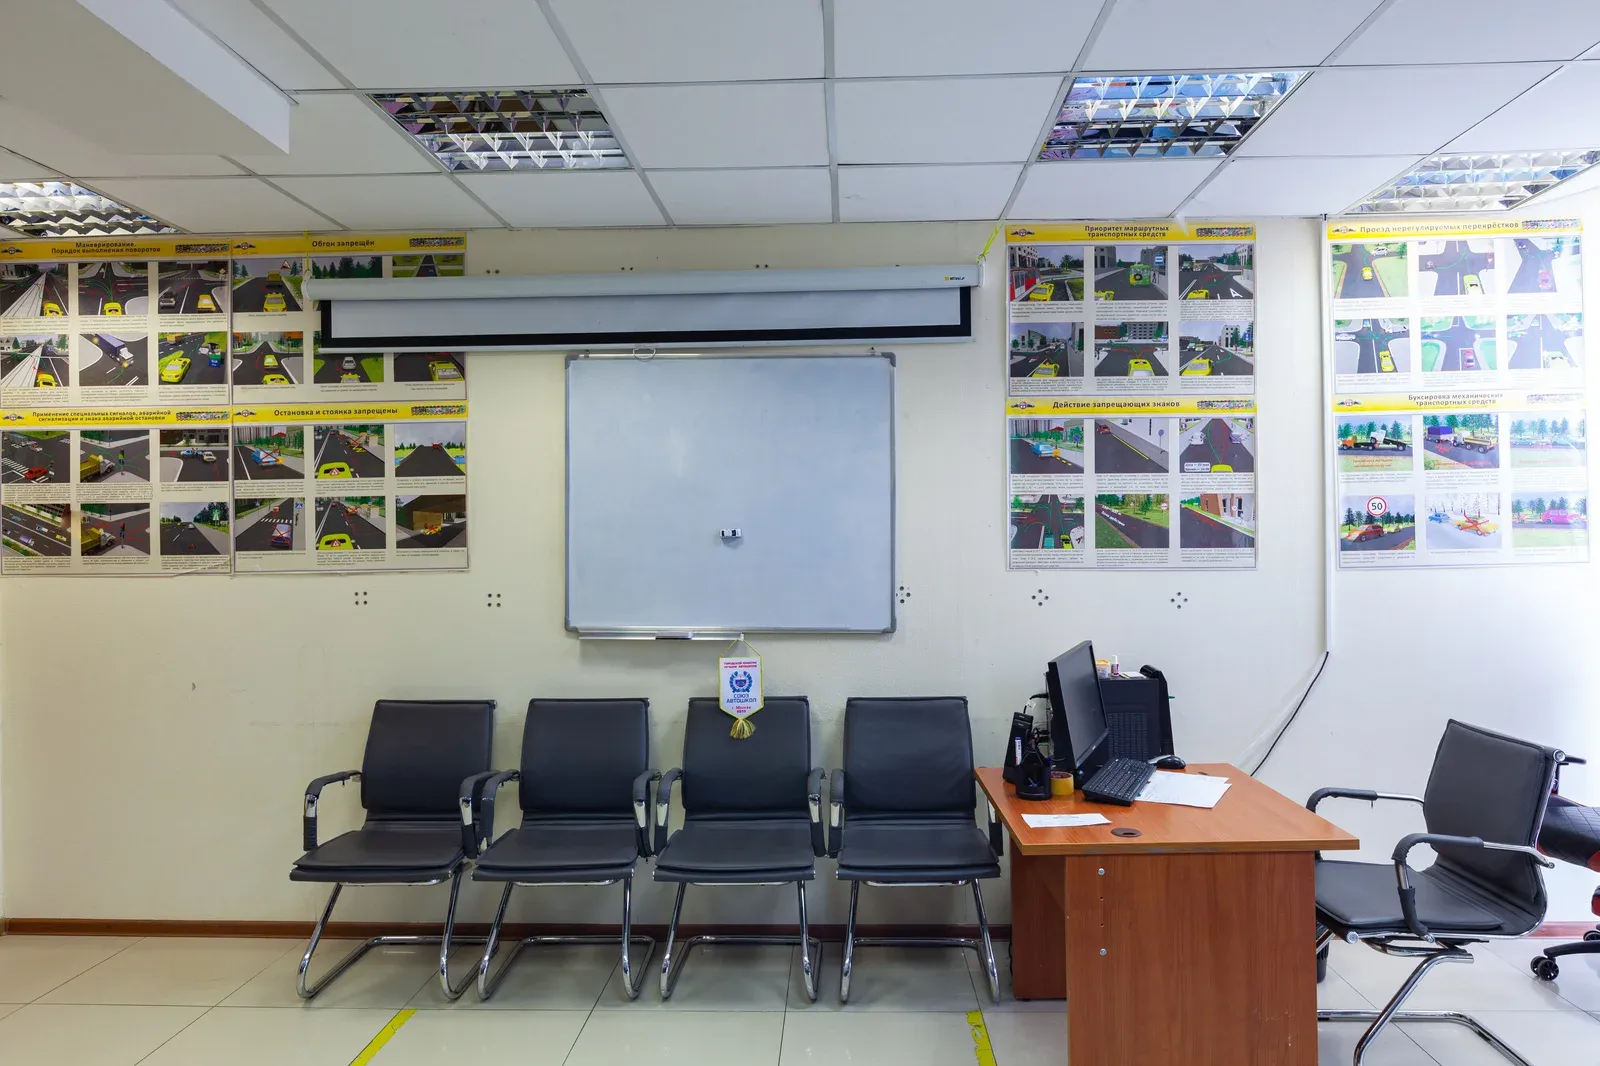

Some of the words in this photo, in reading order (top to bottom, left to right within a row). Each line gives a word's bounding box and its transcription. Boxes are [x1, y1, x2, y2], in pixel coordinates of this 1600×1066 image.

[1085, 225, 1122, 233] Приоритет
[1124, 225, 1169, 233] маршрутных
[1360, 225, 1391, 233] Проезд
[1392, 223, 1461, 233] нерегулируемых
[1462, 221, 1519, 231] перекрёстков
[75, 241, 137, 249] Маневрирование.
[337, 239, 375, 248] запрещён
[51, 247, 81, 255] Порядок
[125, 246, 161, 254] поворотов
[1408, 394, 1451, 402] Буксировка
[1053, 401, 1091, 409] Действие
[1092, 401, 1151, 409] запрещающих
[1415, 399, 1467, 407] транспортных
[1468, 398, 1496, 406] средств
[354, 408, 398, 416] запрещены
[1371, 502, 1383, 511] 50
